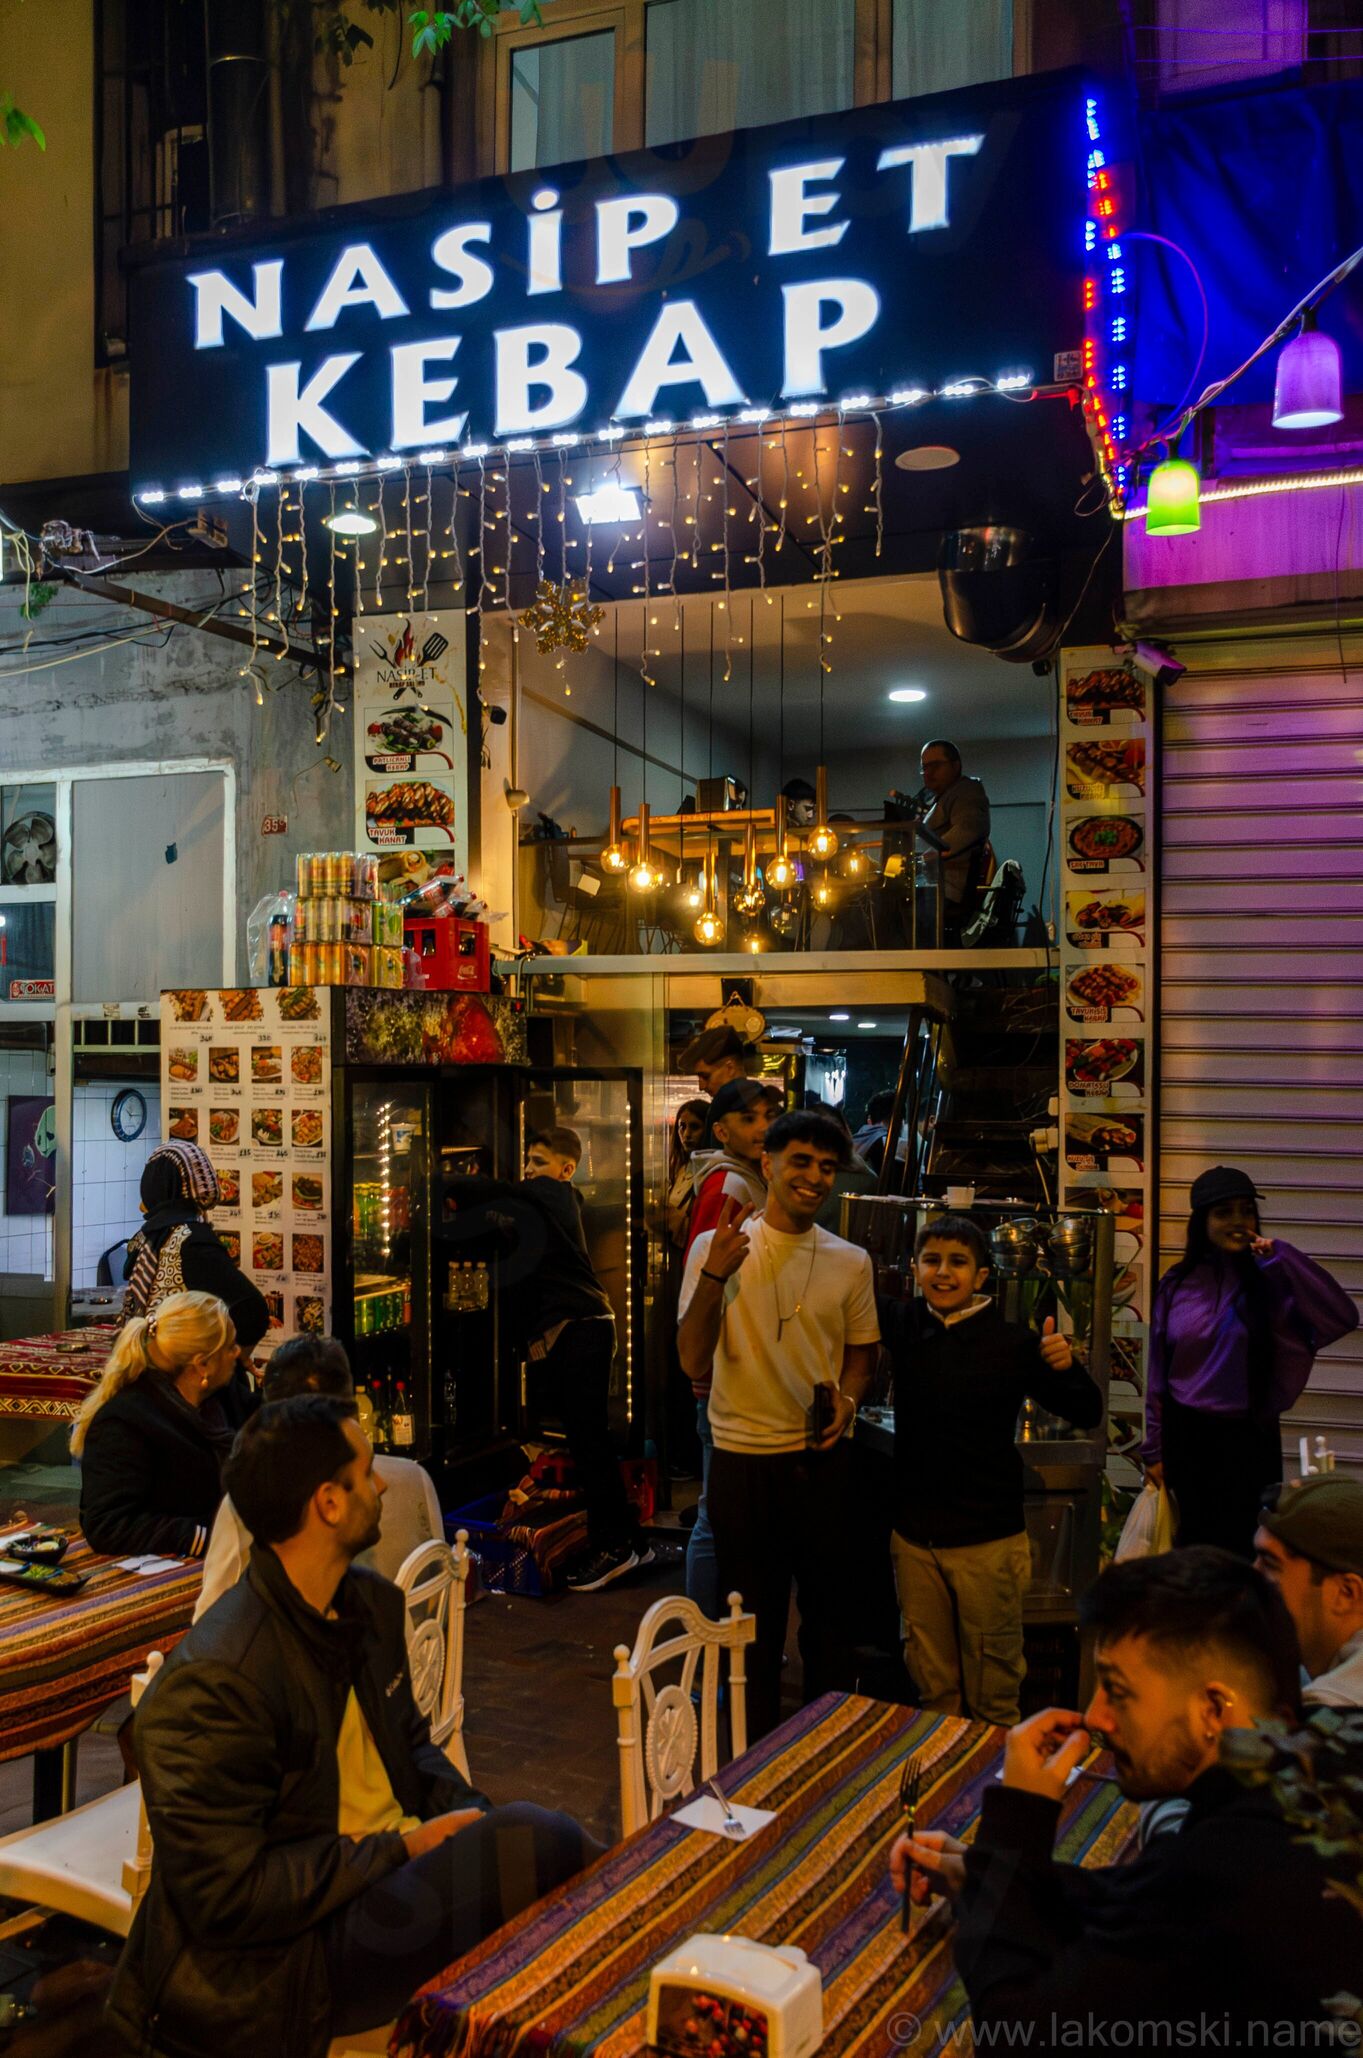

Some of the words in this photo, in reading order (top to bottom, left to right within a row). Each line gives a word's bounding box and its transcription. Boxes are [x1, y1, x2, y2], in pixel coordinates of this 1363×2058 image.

[768, 133, 984, 257] ET
[264, 277, 881, 467] KEBAP
[368, 828, 396, 838] TAVUK
[378, 835, 407, 845] KANAT
